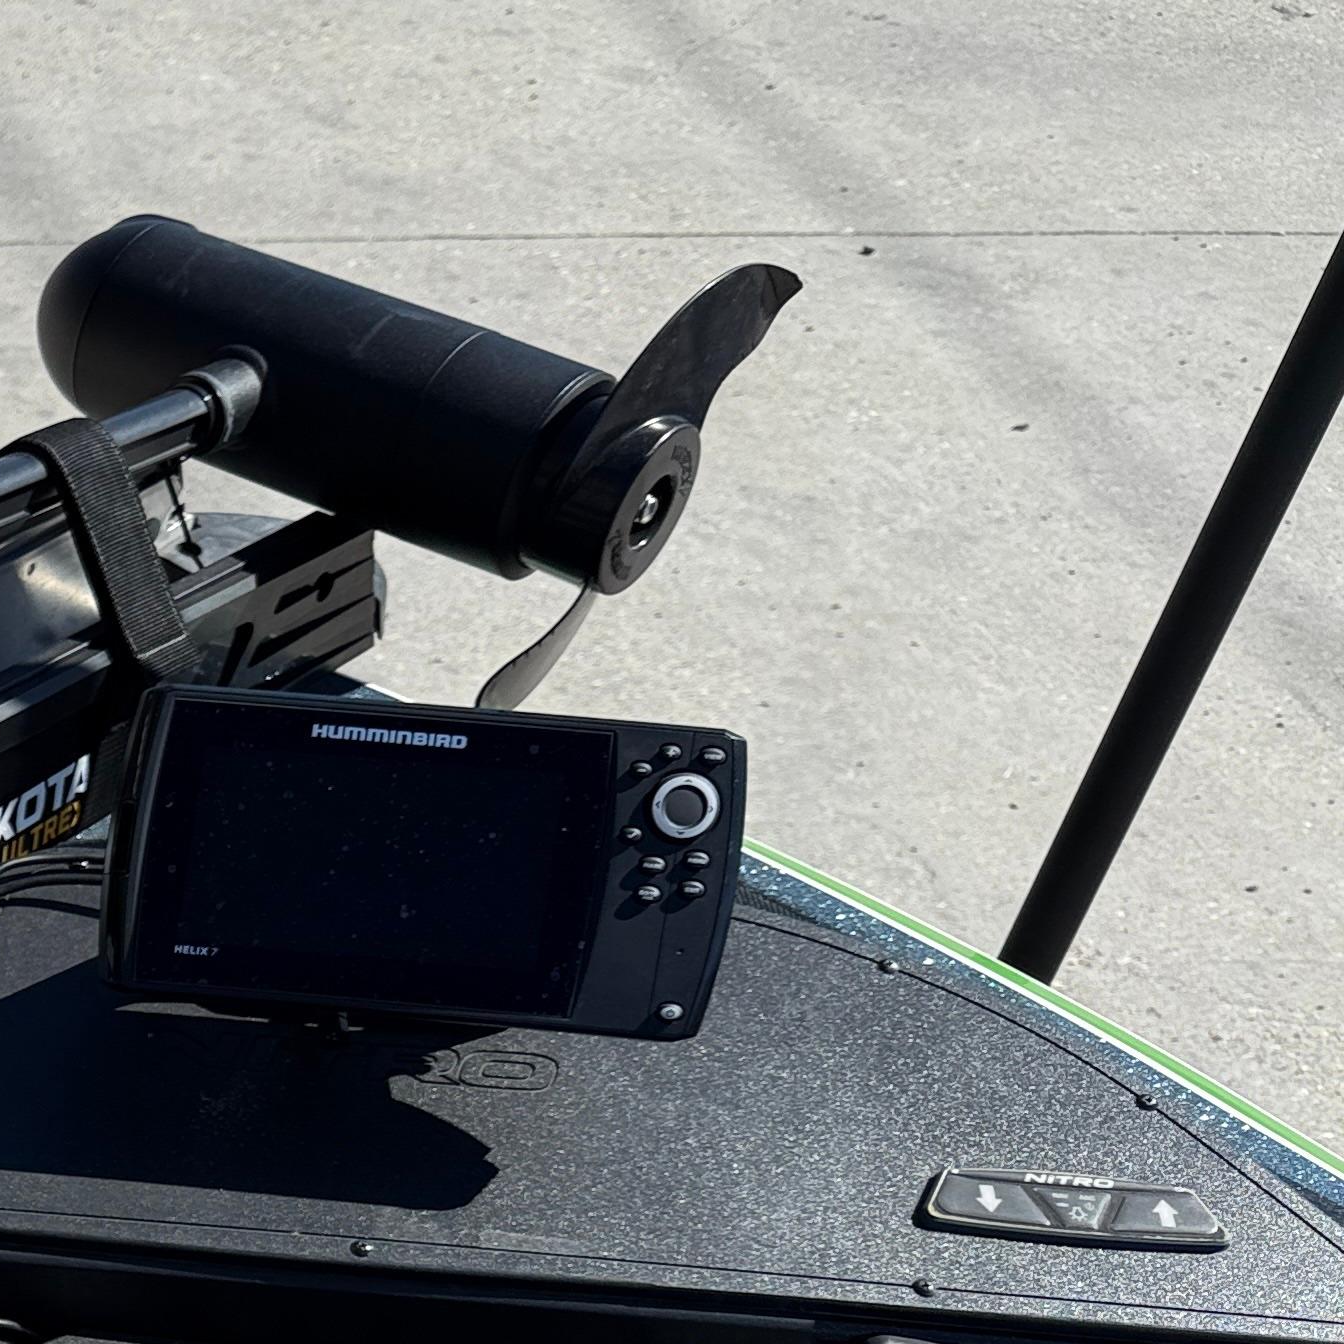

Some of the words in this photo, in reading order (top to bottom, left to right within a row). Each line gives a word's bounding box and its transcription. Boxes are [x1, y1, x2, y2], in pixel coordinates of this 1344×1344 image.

[311, 723, 468, 750] HUMMINBIRD
[174, 944, 208, 957] HELIX
[210, 946, 219, 957] 7
[1023, 1173, 1115, 1189] NITRO
